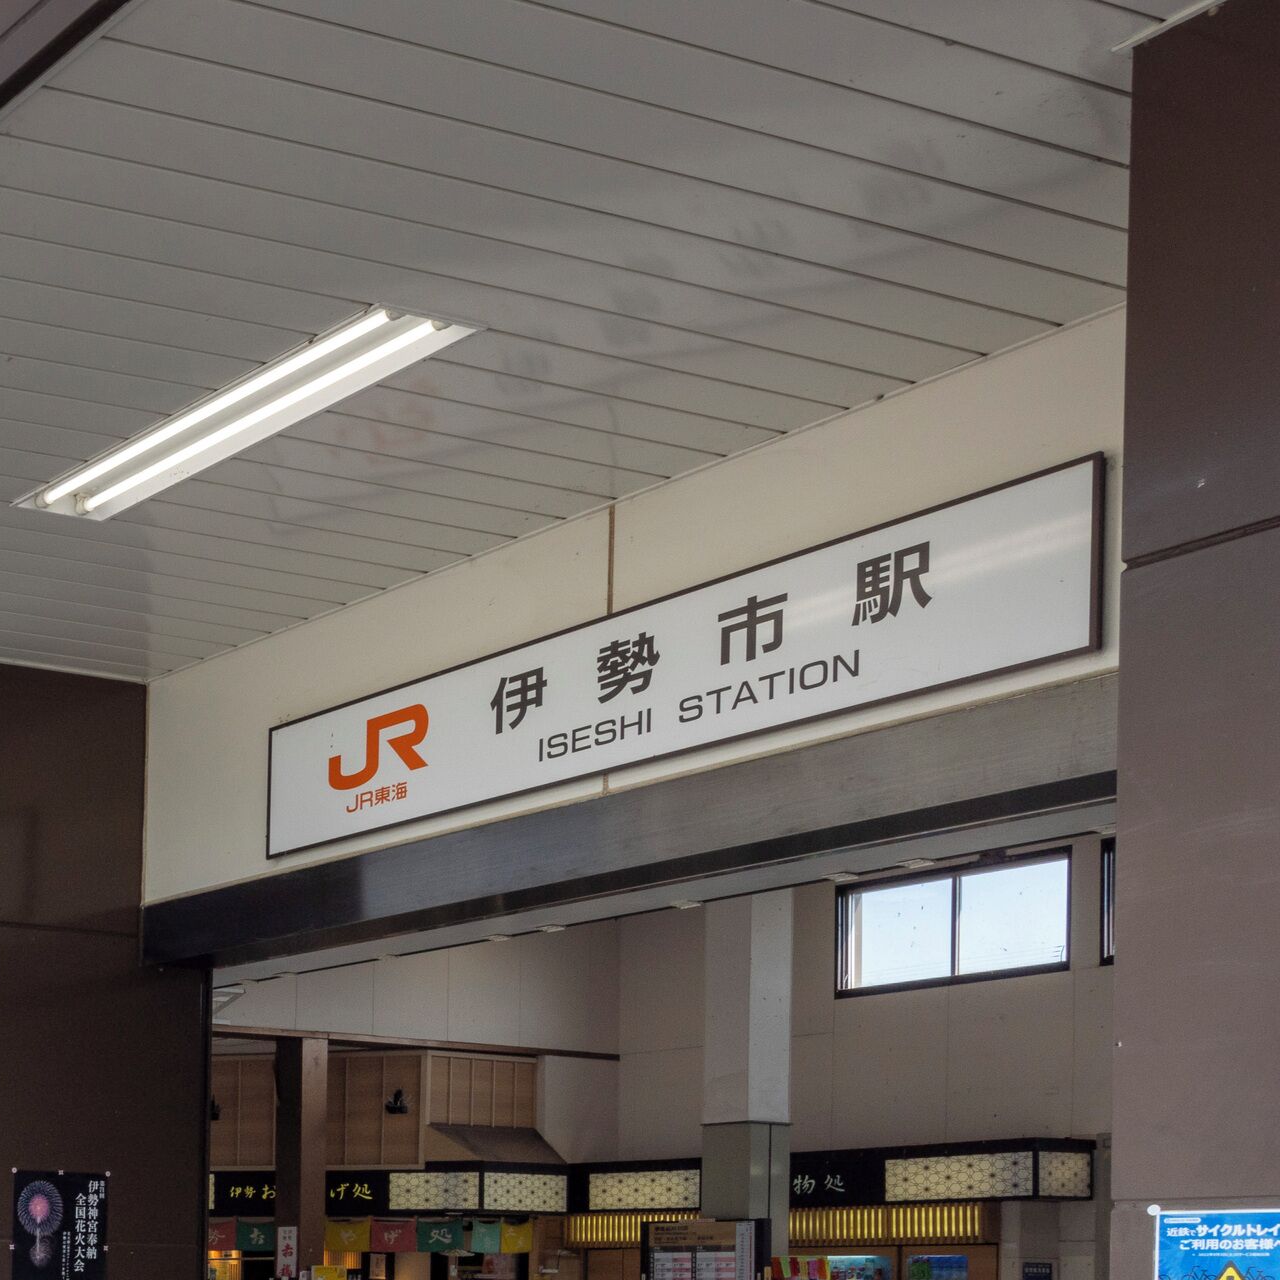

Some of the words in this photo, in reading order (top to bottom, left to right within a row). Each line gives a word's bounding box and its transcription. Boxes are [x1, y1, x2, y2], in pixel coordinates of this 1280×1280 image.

[490, 541, 933, 736] 伊勢市駅
[328, 703, 430, 792] JR
[538, 707, 653, 764] ISESHI
[678, 649, 861, 725] STATION
[345, 781, 409, 815] JR東海
[74, 1192, 87, 1273] 全国花火大会
[86, 1180, 99, 1260] 伊勢神宮奉納
